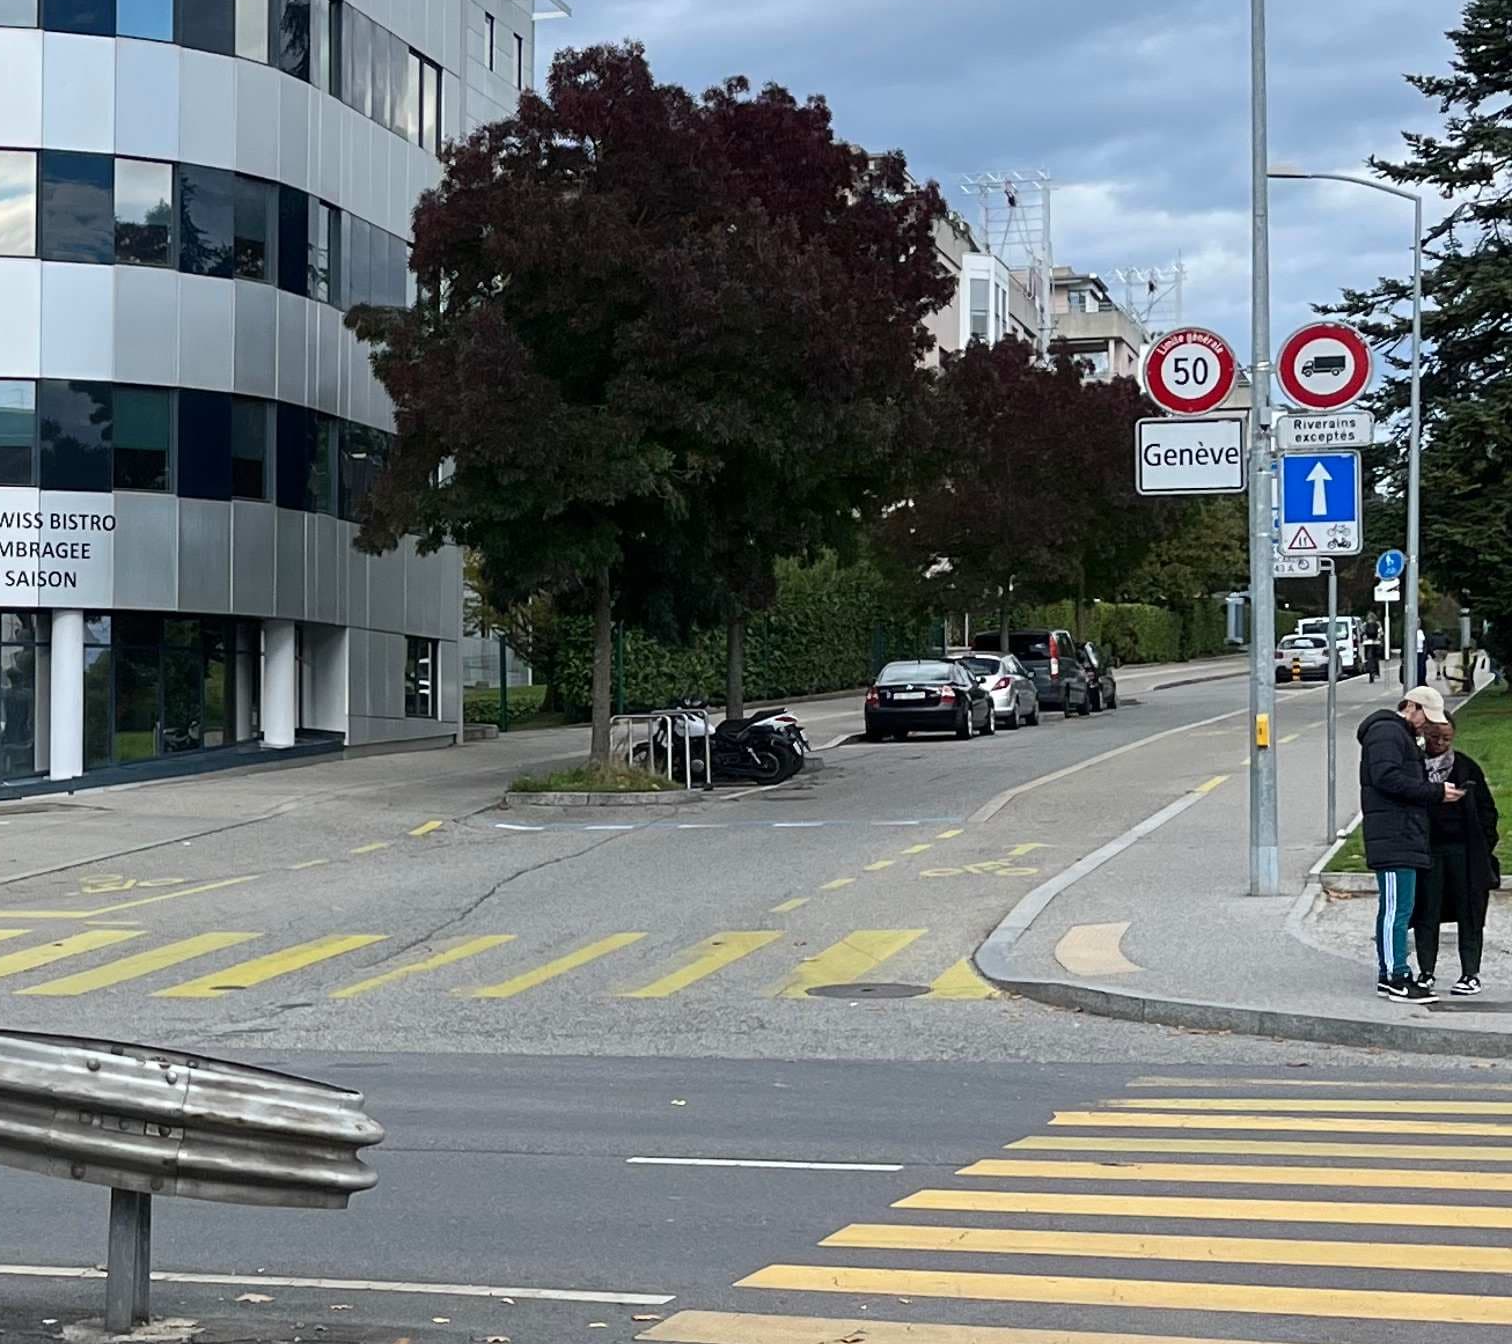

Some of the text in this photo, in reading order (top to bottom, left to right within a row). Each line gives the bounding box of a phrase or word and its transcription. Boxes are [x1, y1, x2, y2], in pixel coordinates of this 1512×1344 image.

[1173, 356, 1209, 386] 50
[1293, 418, 1357, 430] Riverains
[1294, 430, 1356, 444] exceptés
[1143, 441, 1239, 467] Genève
[49, 513, 116, 532] BISTRO
[5, 570, 78, 588] SAISON
